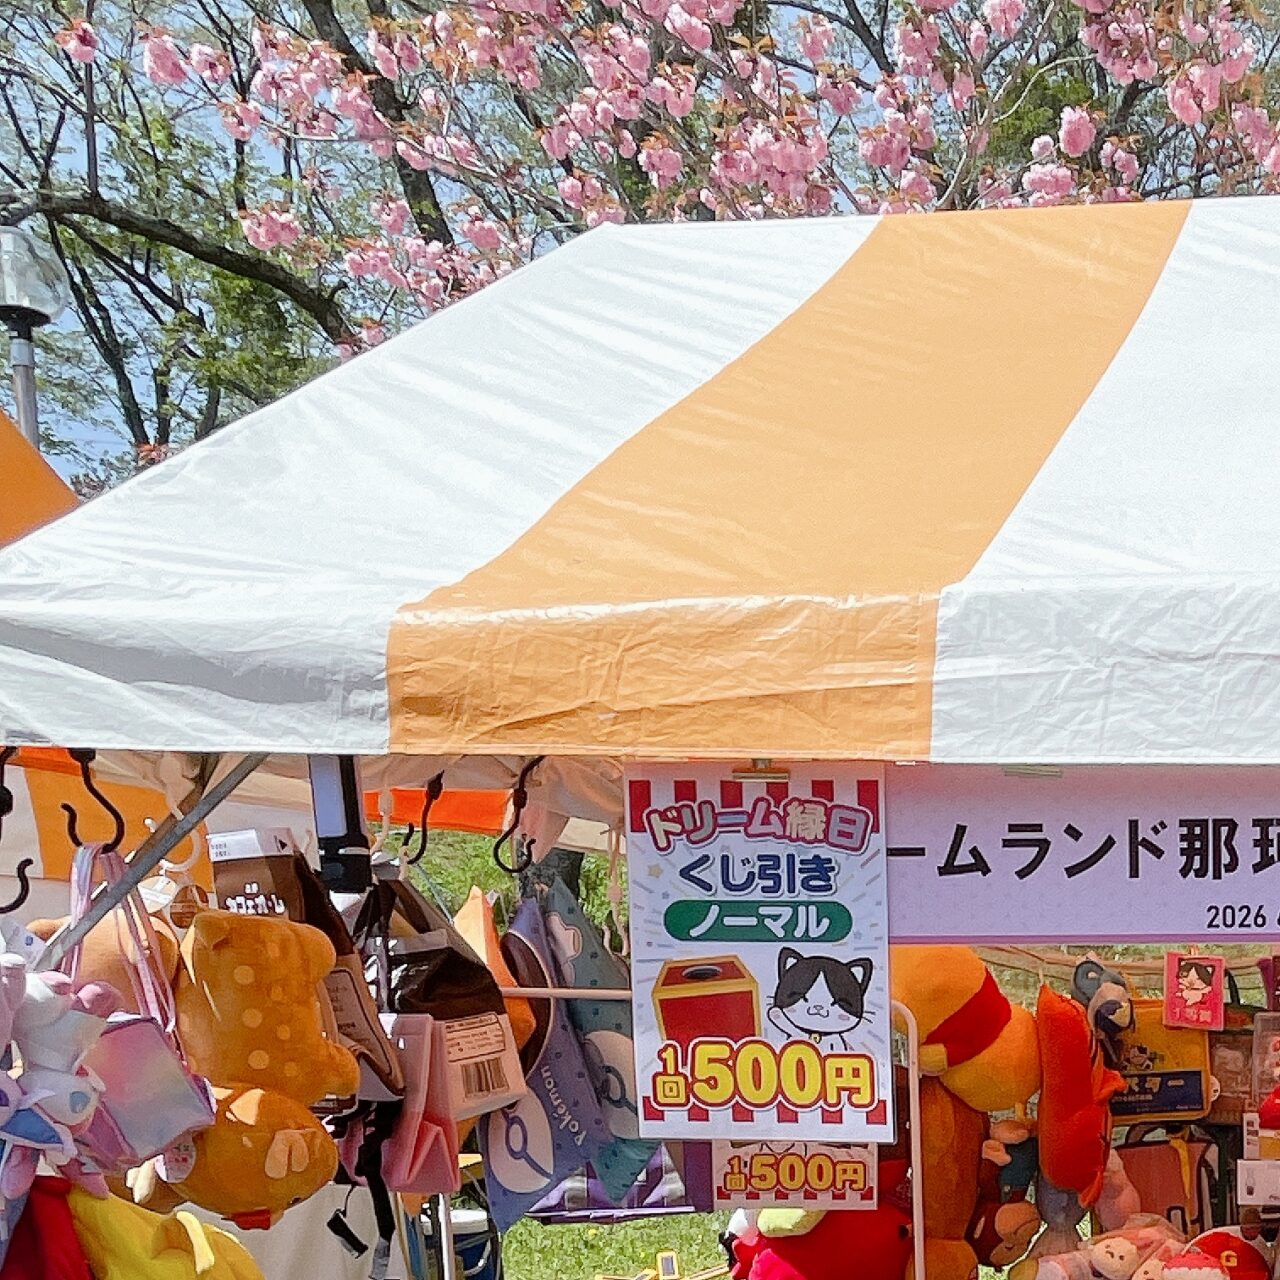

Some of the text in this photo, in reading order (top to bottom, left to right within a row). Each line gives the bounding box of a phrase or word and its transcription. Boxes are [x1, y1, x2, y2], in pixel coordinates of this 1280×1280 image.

[645, 798, 871, 850] ドリーム縁日
[679, 853, 838, 895] くじ引き
[689, 904, 830, 938] ノーマル
[1206, 905, 1266, 930] 2026
[541, 1066, 588, 1146] Pokémon
[1220, 1250, 1238, 1267] G
